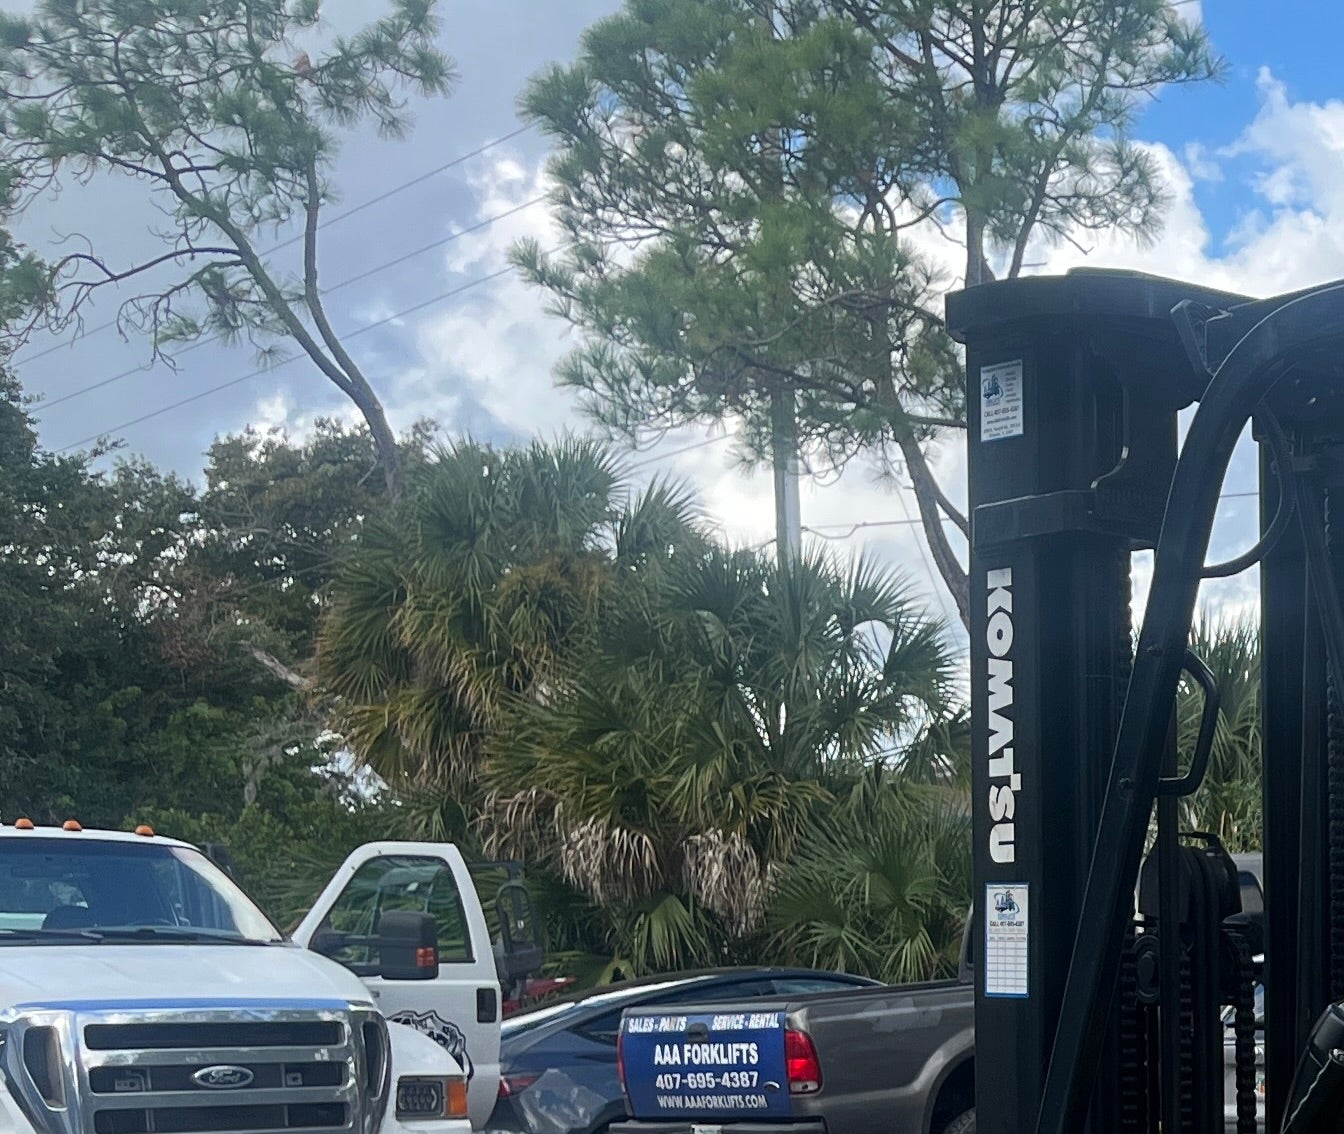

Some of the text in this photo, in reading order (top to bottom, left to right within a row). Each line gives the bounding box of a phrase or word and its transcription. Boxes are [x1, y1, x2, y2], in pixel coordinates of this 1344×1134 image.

[987, 567, 1022, 864] KOMATSU
[628, 1012, 780, 1033] SALES PARTS SERVICE RENTAL
[654, 1042, 759, 1065] AAA FORKLIFTS
[655, 1071, 759, 1090] 407-695-4387
